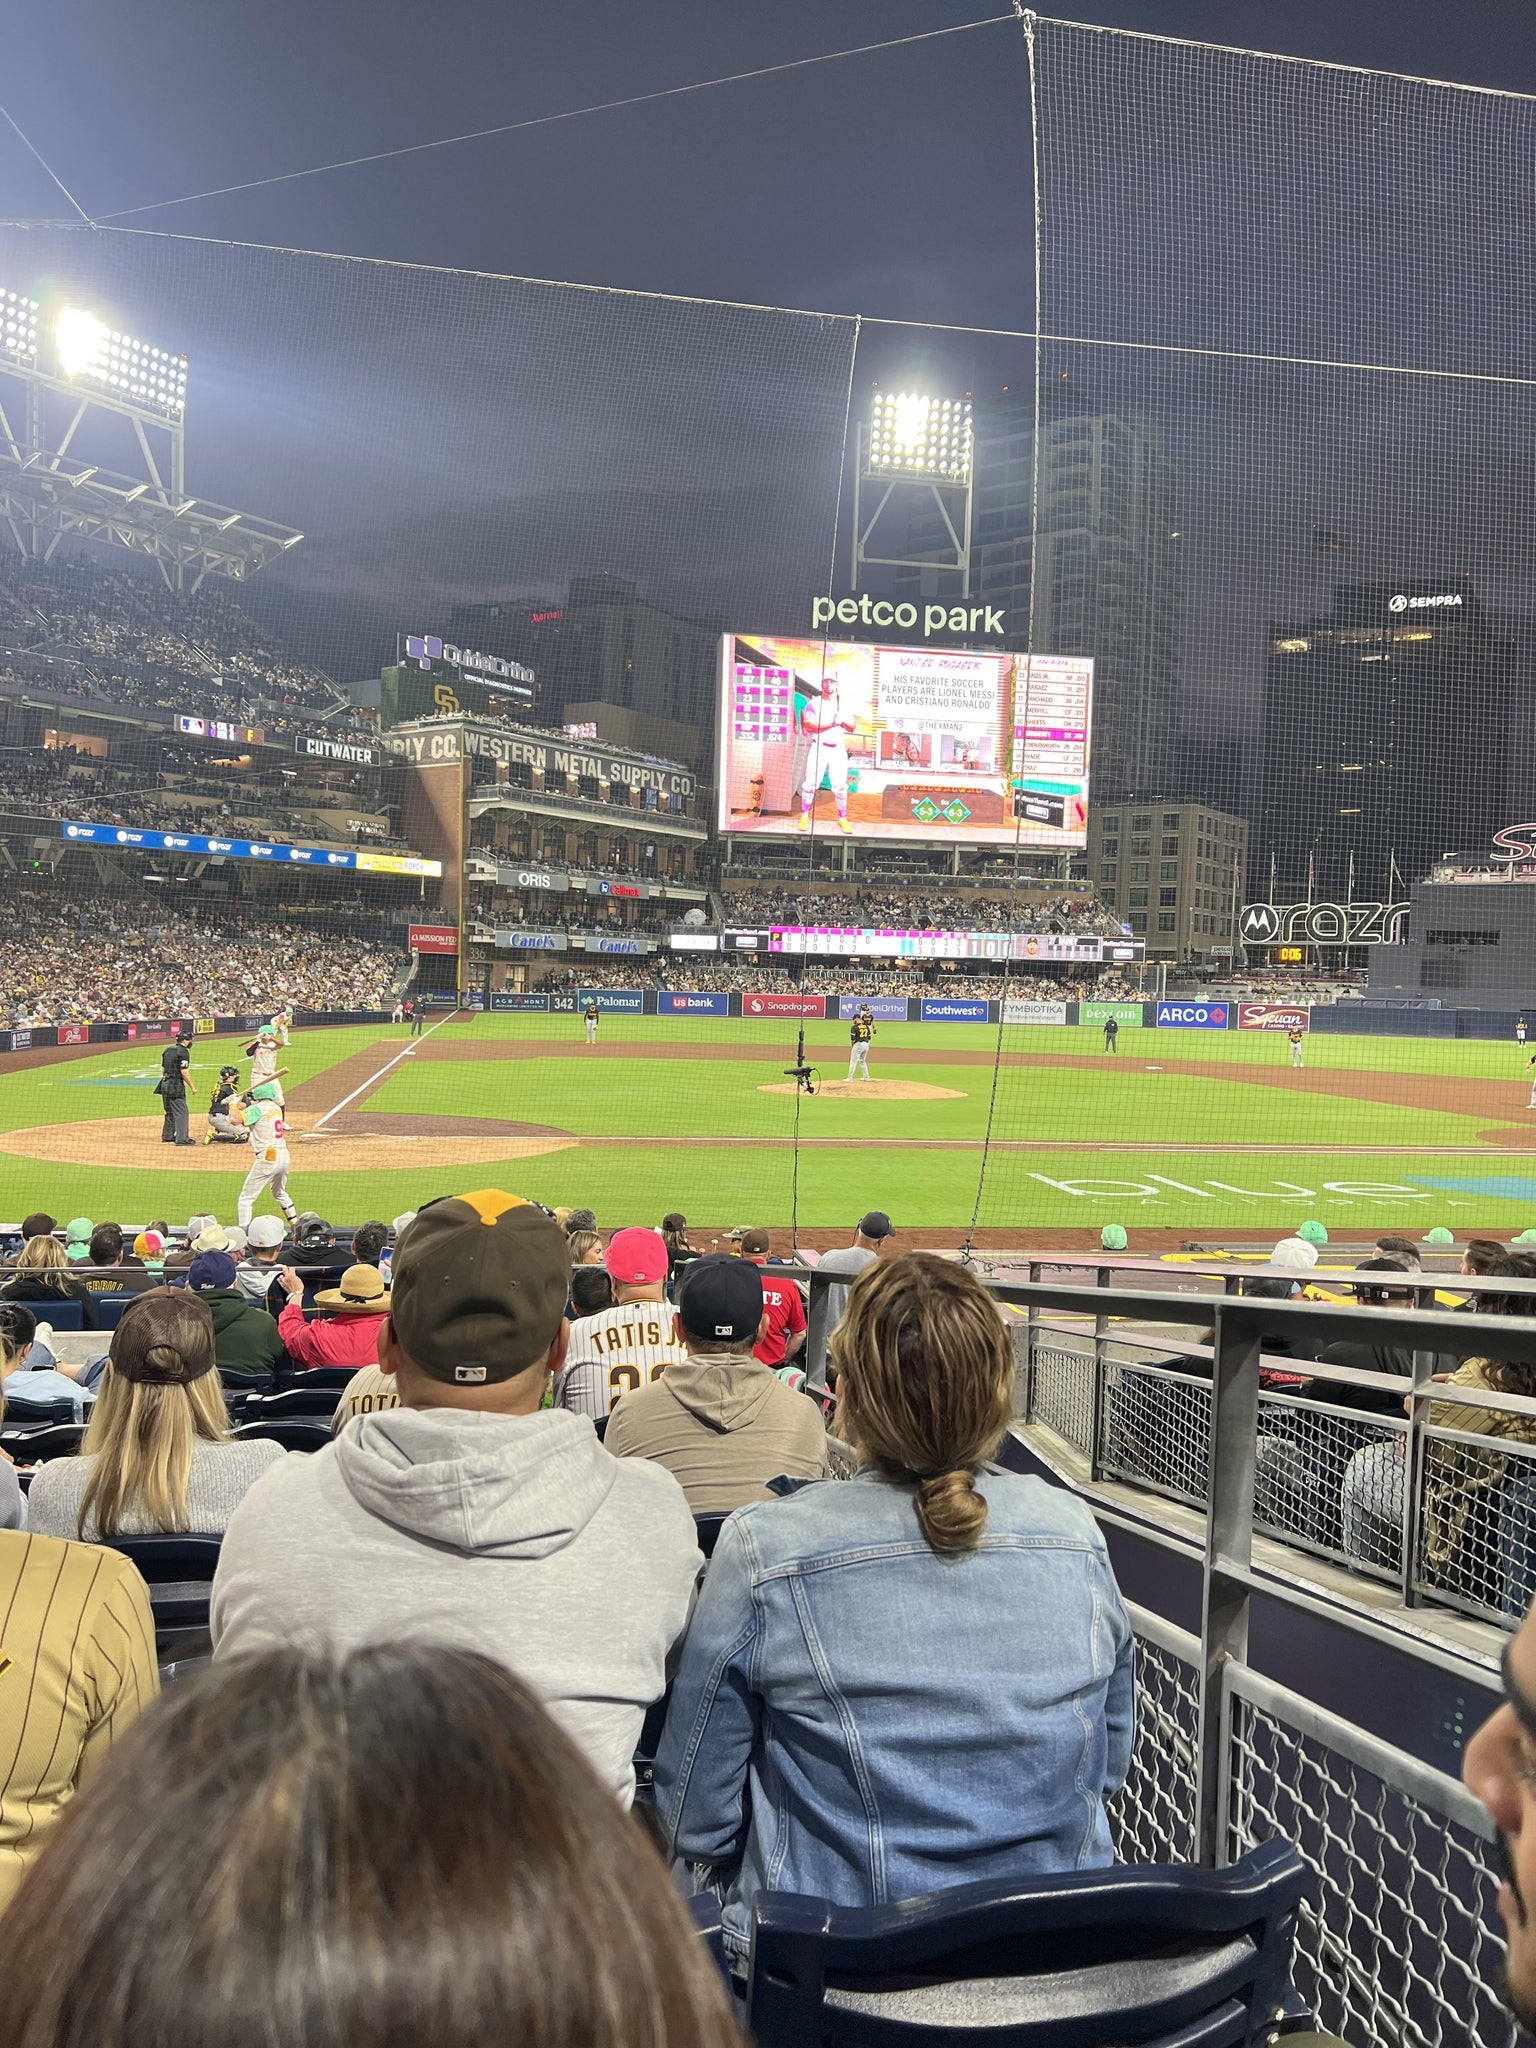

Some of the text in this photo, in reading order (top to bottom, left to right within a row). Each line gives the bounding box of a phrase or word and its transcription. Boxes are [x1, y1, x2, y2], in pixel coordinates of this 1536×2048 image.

[1409, 594, 1463, 608] SEMPRA
[812, 593, 1005, 637] petco park
[443, 644, 535, 683] QuidelOrtho
[894, 675, 984, 689] HIS FAVORITE SOCCER
[742, 694, 779, 704] 23 3
[881, 684, 995, 700] PLAYERS ARE LIONEL MESSI
[885, 695, 990, 710] AND CRISTIANO RONALDO
[917, 721, 964, 732] @THEXMAN2
[247, 729, 254, 742] F
[306, 738, 373, 764] CUTWATER
[431, 734, 461, 759] CO.
[464, 732, 694, 796] WESTERN METAL SUPPLY CO.
[919, 807, 934, 816] 5-3
[78, 828, 96, 838] razr
[127, 833, 144, 843] razr
[173, 837, 190, 848] razr
[217, 842, 233, 851] razr
[518, 873, 551, 888] ORIS
[609, 884, 641, 898] Calimax
[1281, 902, 1411, 945] razr
[418, 934, 445, 943] MISSION
[445, 935, 457, 944] FED
[511, 932, 556, 949] Canel's
[773, 933, 780, 941] P
[600, 938, 639, 954] Canel's
[469, 947, 486, 960] 336
[1280, 948, 1302, 961] 0:06
[554, 998, 574, 1010] 342
[596, 996, 640, 1008] Palomar
[673, 997, 714, 1008] us bank
[767, 1001, 818, 1012] Snapdragon
[925, 1005, 977, 1015] Southwest
[1159, 1008, 1208, 1023] ARCO
[1243, 1006, 1303, 1029] Sycuan
[859, 1029, 868, 1038] 27
[274, 1119, 284, 1139] 9
[1026, 1172, 1434, 1198] blue
[590, 1321, 660, 1355] TATIS
